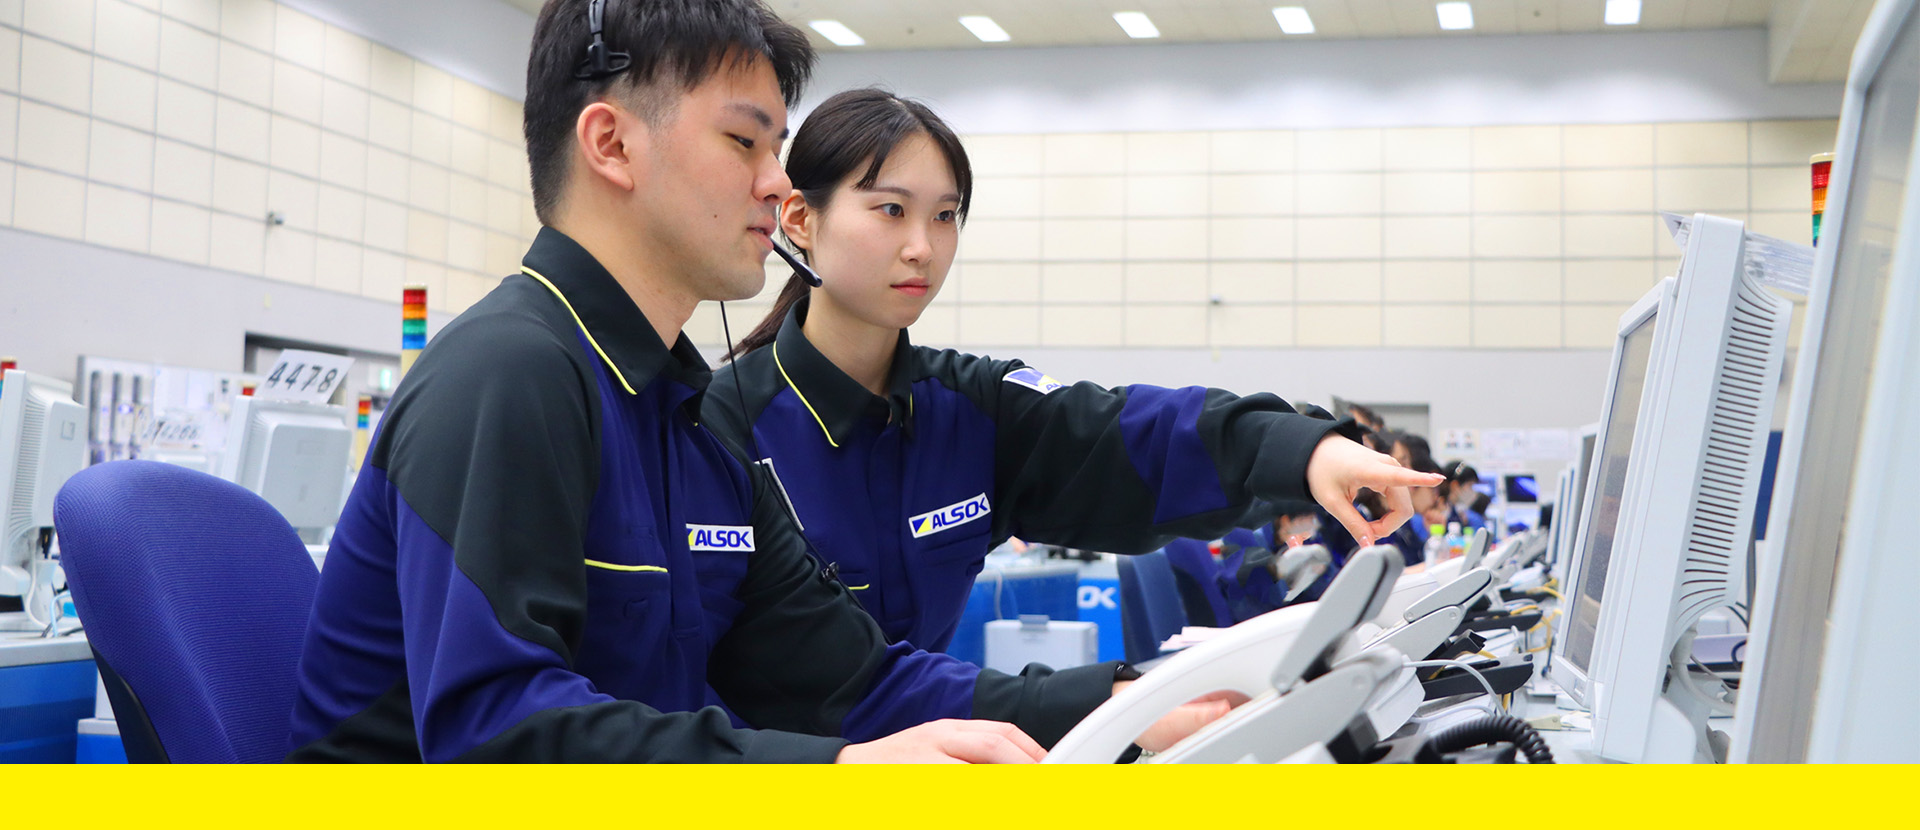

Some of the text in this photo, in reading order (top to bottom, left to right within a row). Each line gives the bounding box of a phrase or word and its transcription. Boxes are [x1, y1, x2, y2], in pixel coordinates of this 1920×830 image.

[266, 361, 338, 393] 4478
[932, 497, 988, 530] ALSOK
[694, 529, 752, 548] ALSOK
